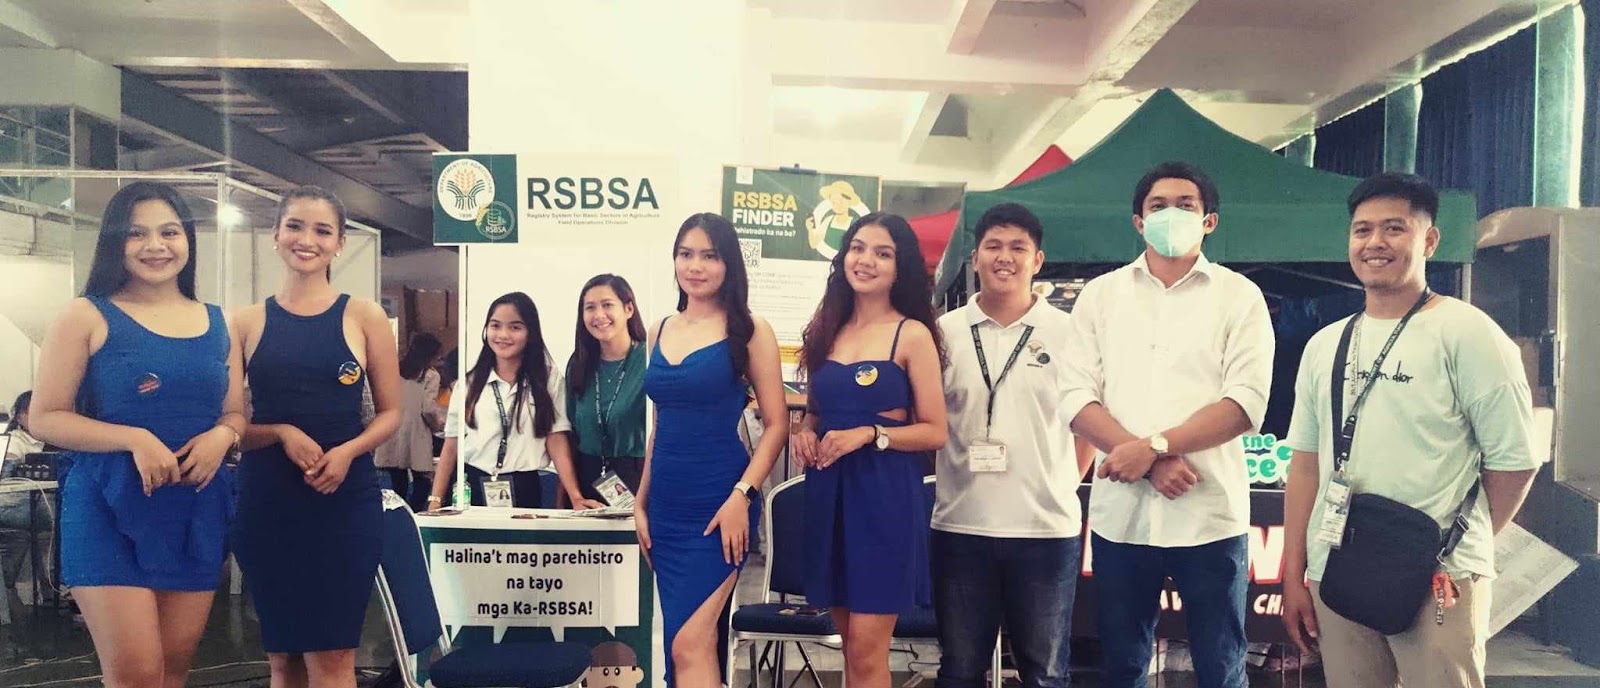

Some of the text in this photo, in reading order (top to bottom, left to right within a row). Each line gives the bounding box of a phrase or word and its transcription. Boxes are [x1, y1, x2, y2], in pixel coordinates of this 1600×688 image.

[527, 177, 660, 210] RSBSA
[733, 191, 798, 211] RSBSA
[732, 208, 795, 227] FINDER
[485, 225, 507, 233] RSBSA
[444, 548, 624, 567] Halina't mag parehistro
[506, 575, 563, 592] na tayo
[477, 601, 593, 618] mga Ka-RSBSA!
